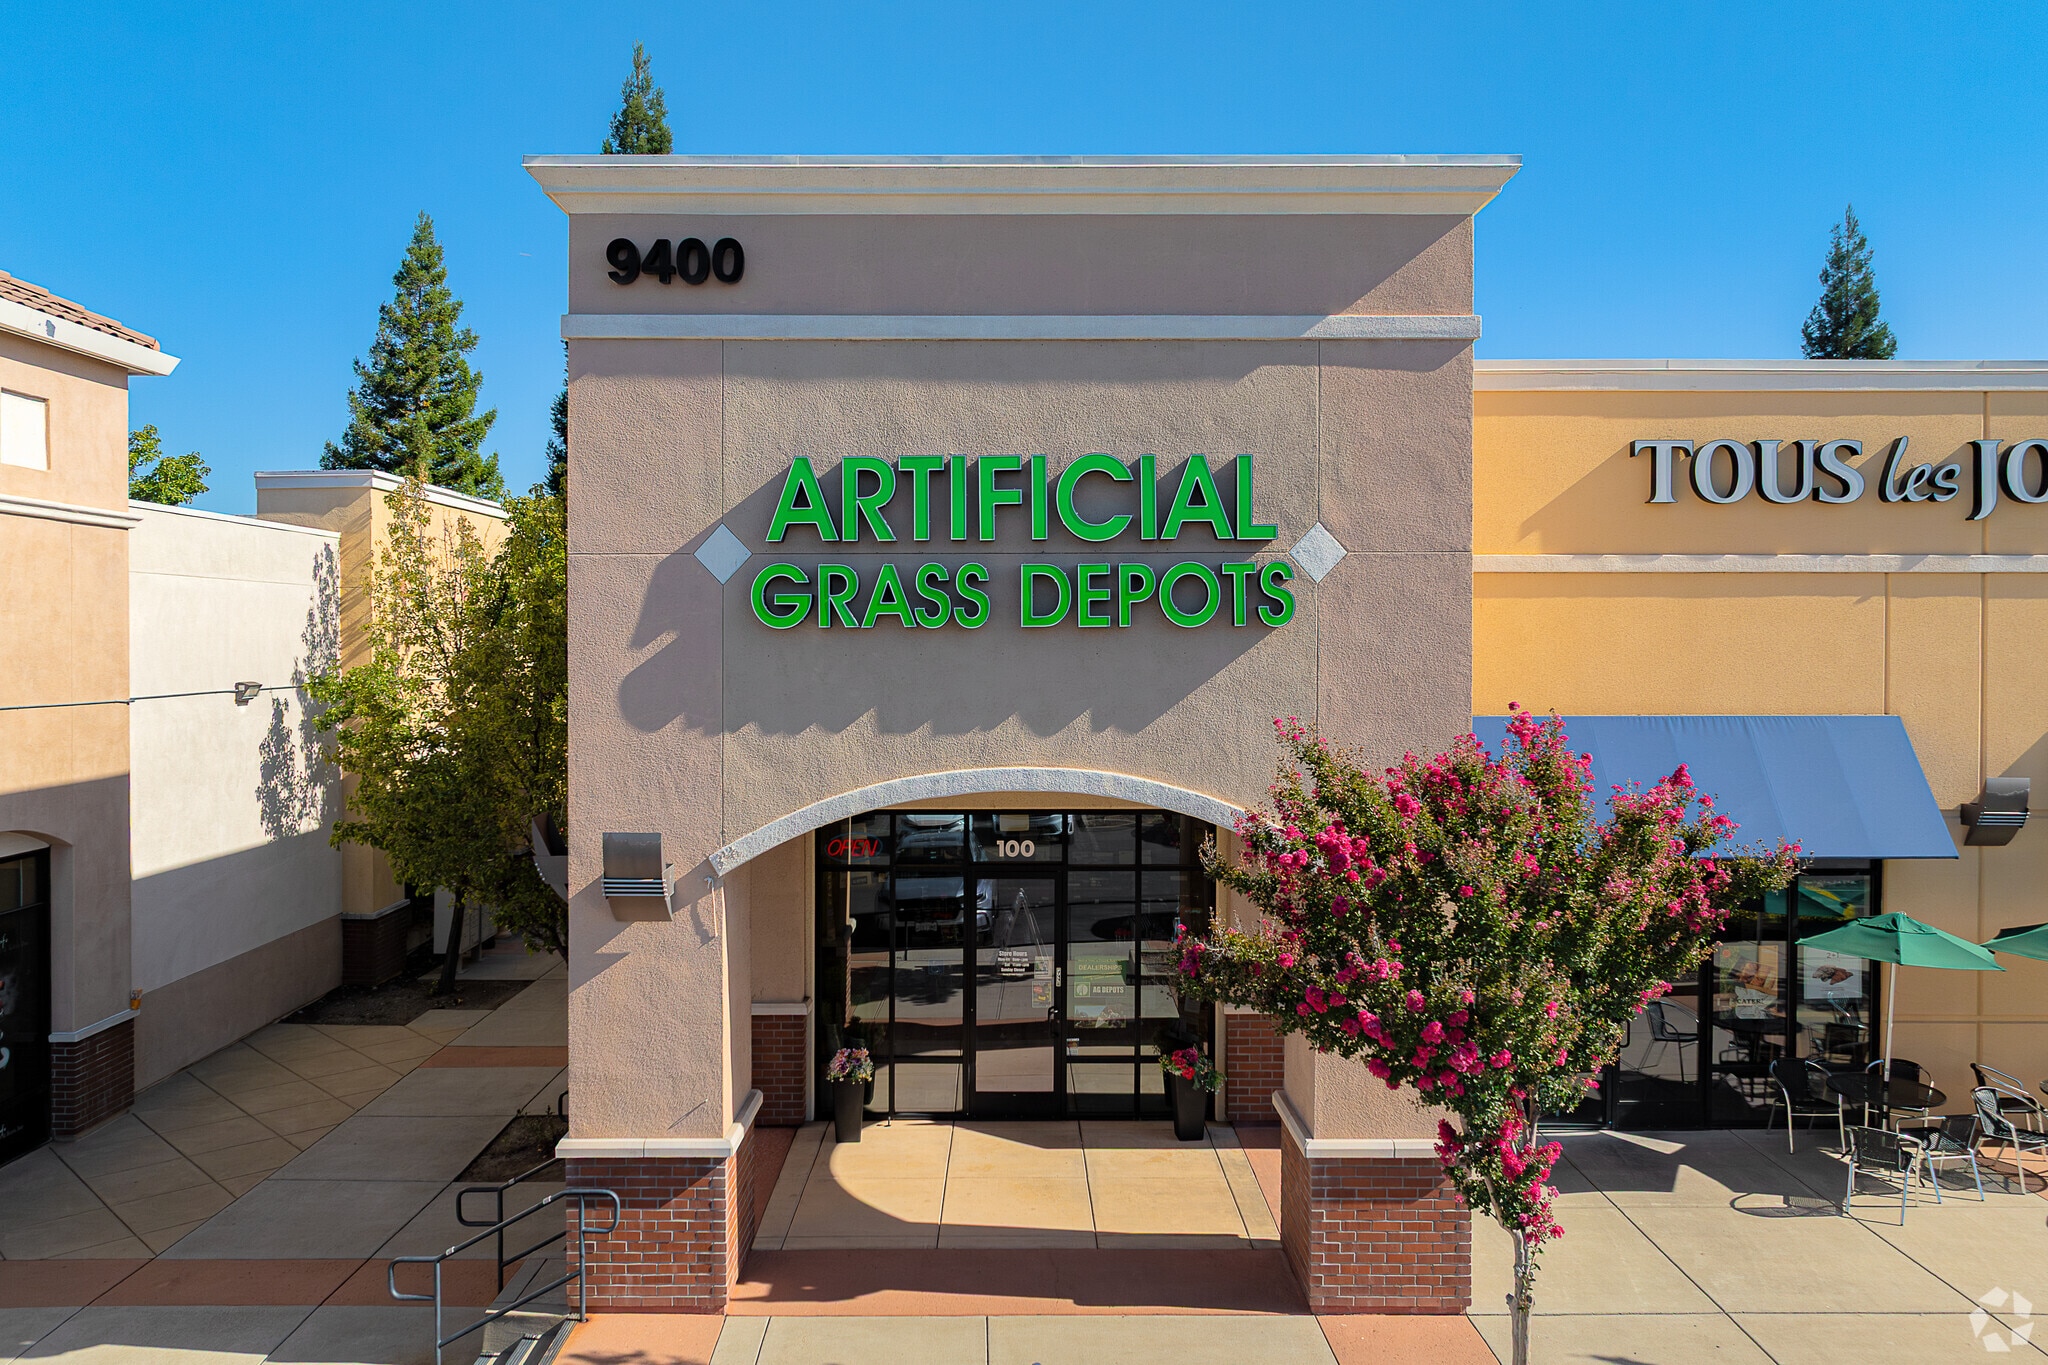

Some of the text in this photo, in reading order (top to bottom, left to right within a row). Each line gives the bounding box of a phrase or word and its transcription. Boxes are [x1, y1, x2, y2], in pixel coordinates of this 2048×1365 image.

[606, 237, 745, 285] 9400
[1630, 438, 1866, 504] TOUS
[1878, 435, 1962, 504] les
[765, 452, 1279, 543] ARTIFICIAL
[750, 560, 1297, 629] GRASS DEPOTS
[827, 838, 879, 857] OPEN
[996, 839, 1035, 858] 100
[1102, 985, 1124, 993] DEPOTS
